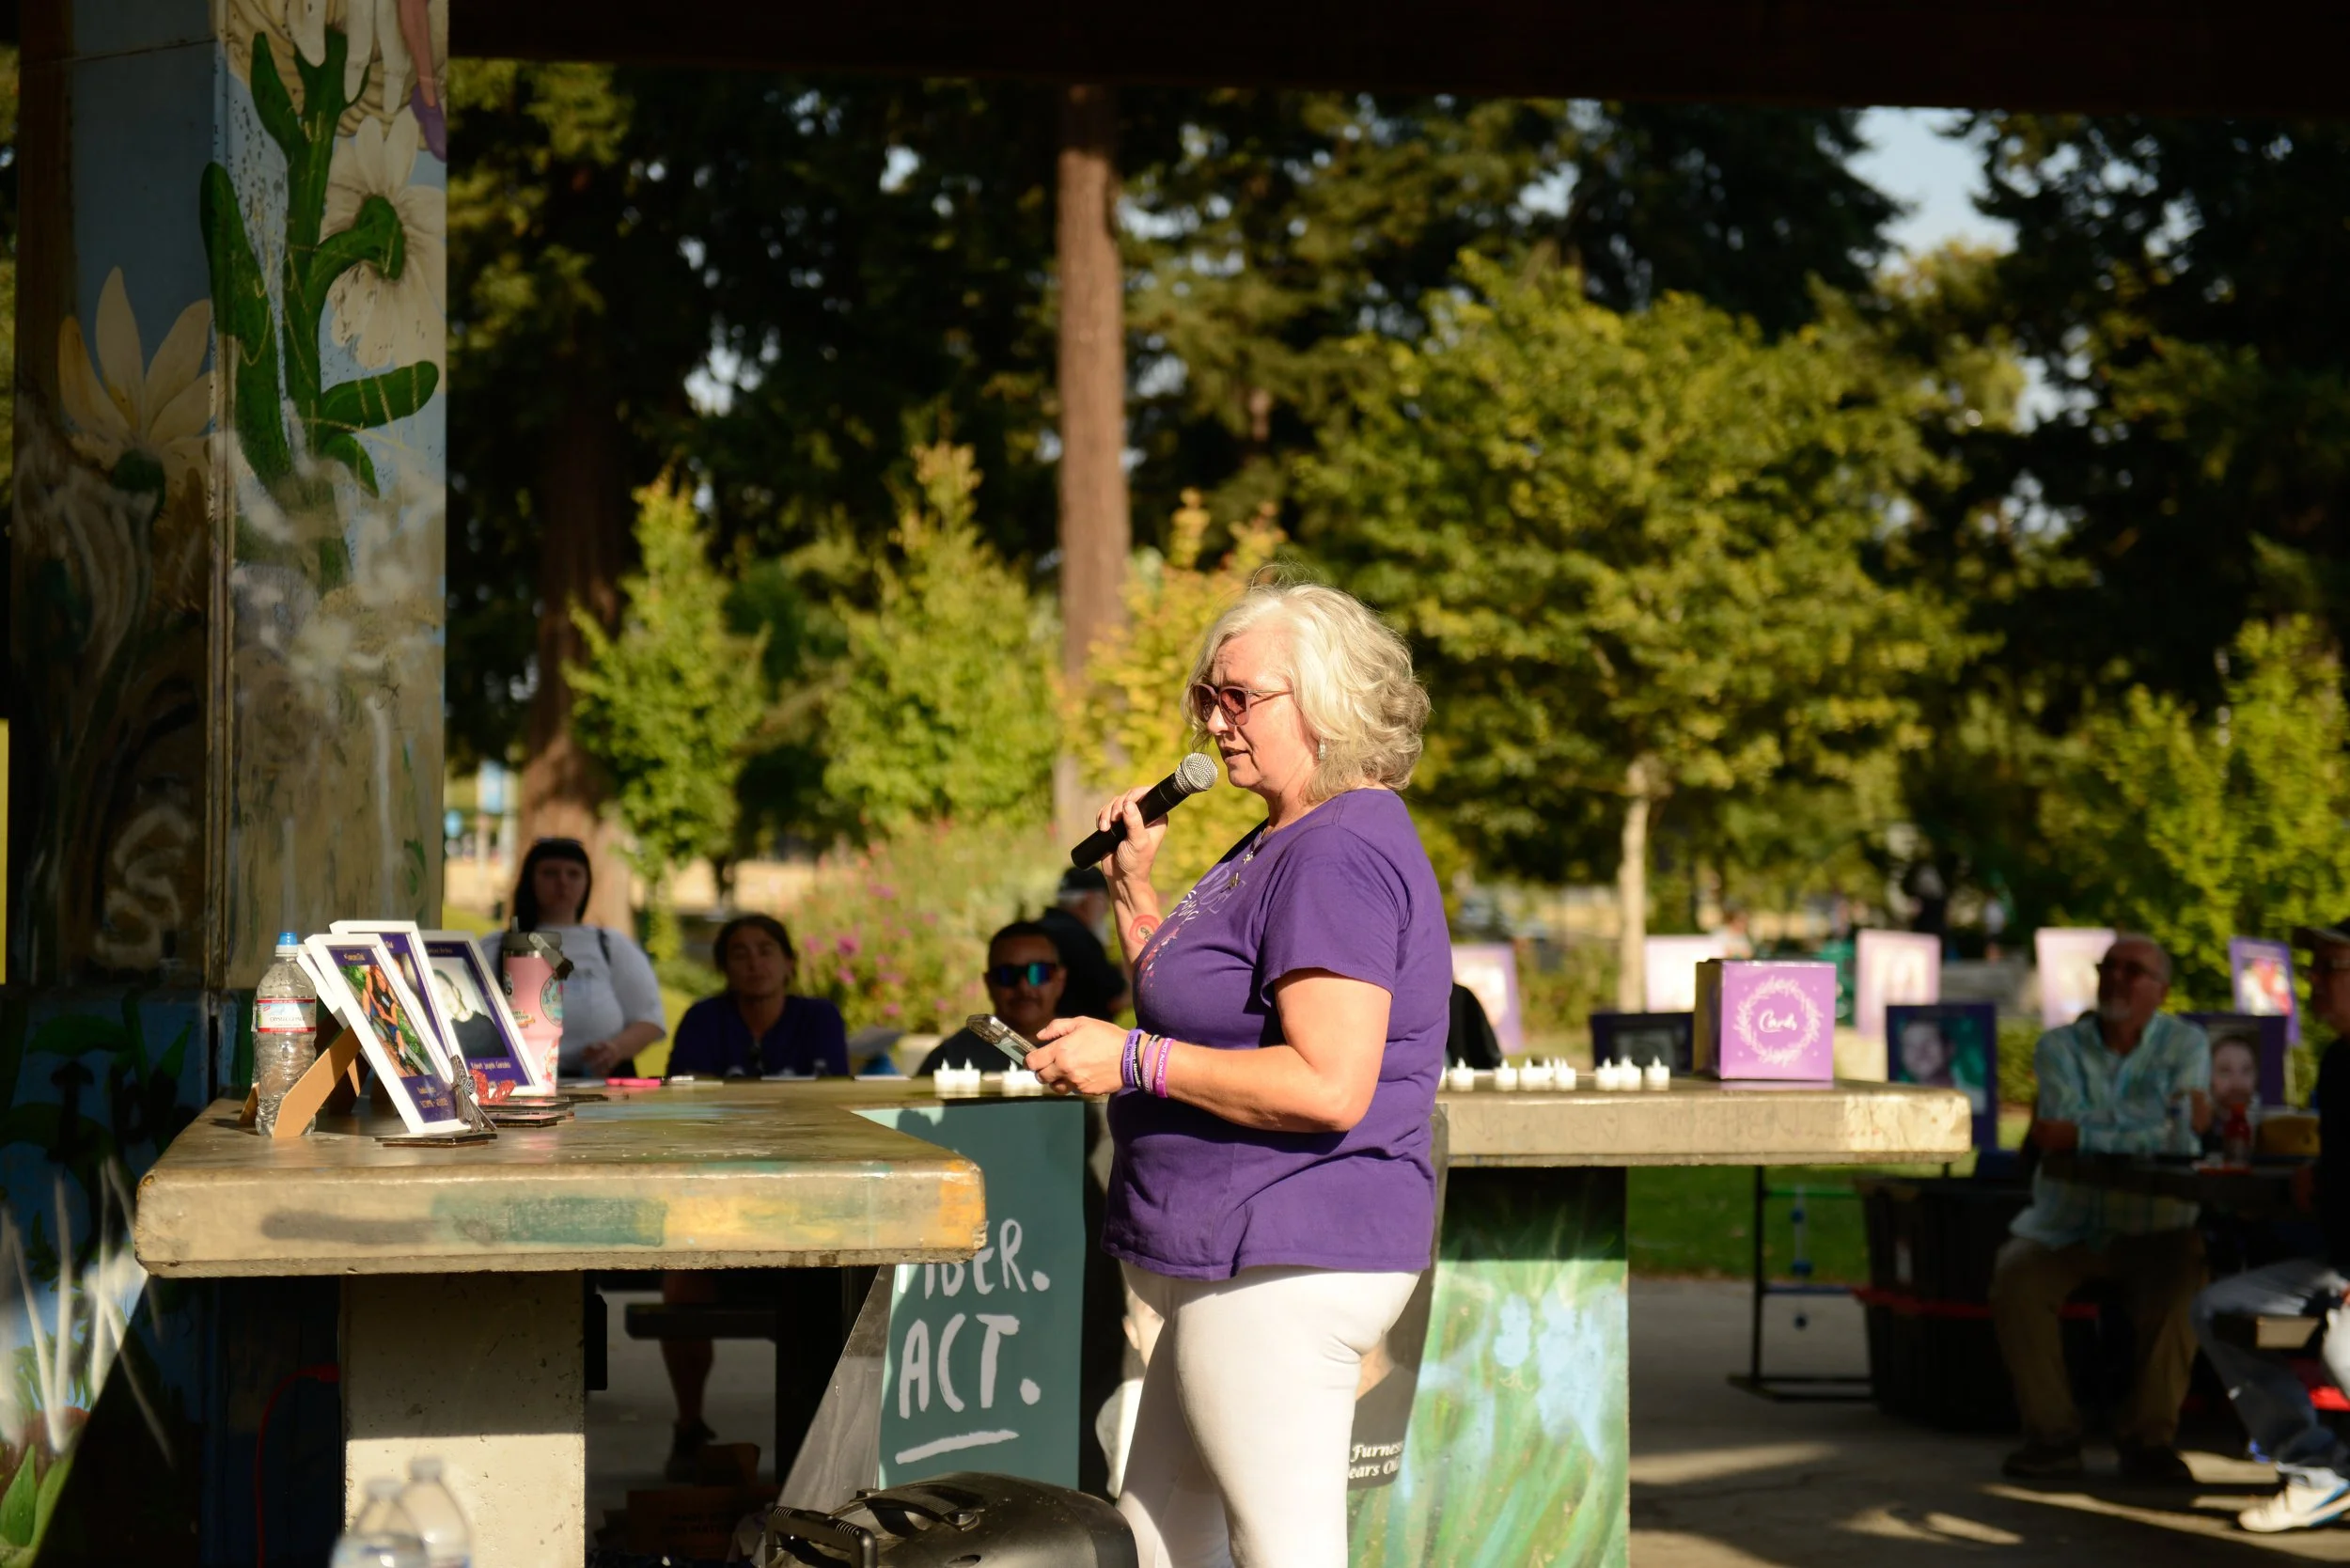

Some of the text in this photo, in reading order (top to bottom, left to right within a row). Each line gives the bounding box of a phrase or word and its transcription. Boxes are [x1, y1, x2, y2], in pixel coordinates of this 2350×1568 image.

[1759, 1009, 1798, 1033] Cards
[899, 1313, 1041, 1419] ACT.
[1348, 1464, 1380, 1479] ears
